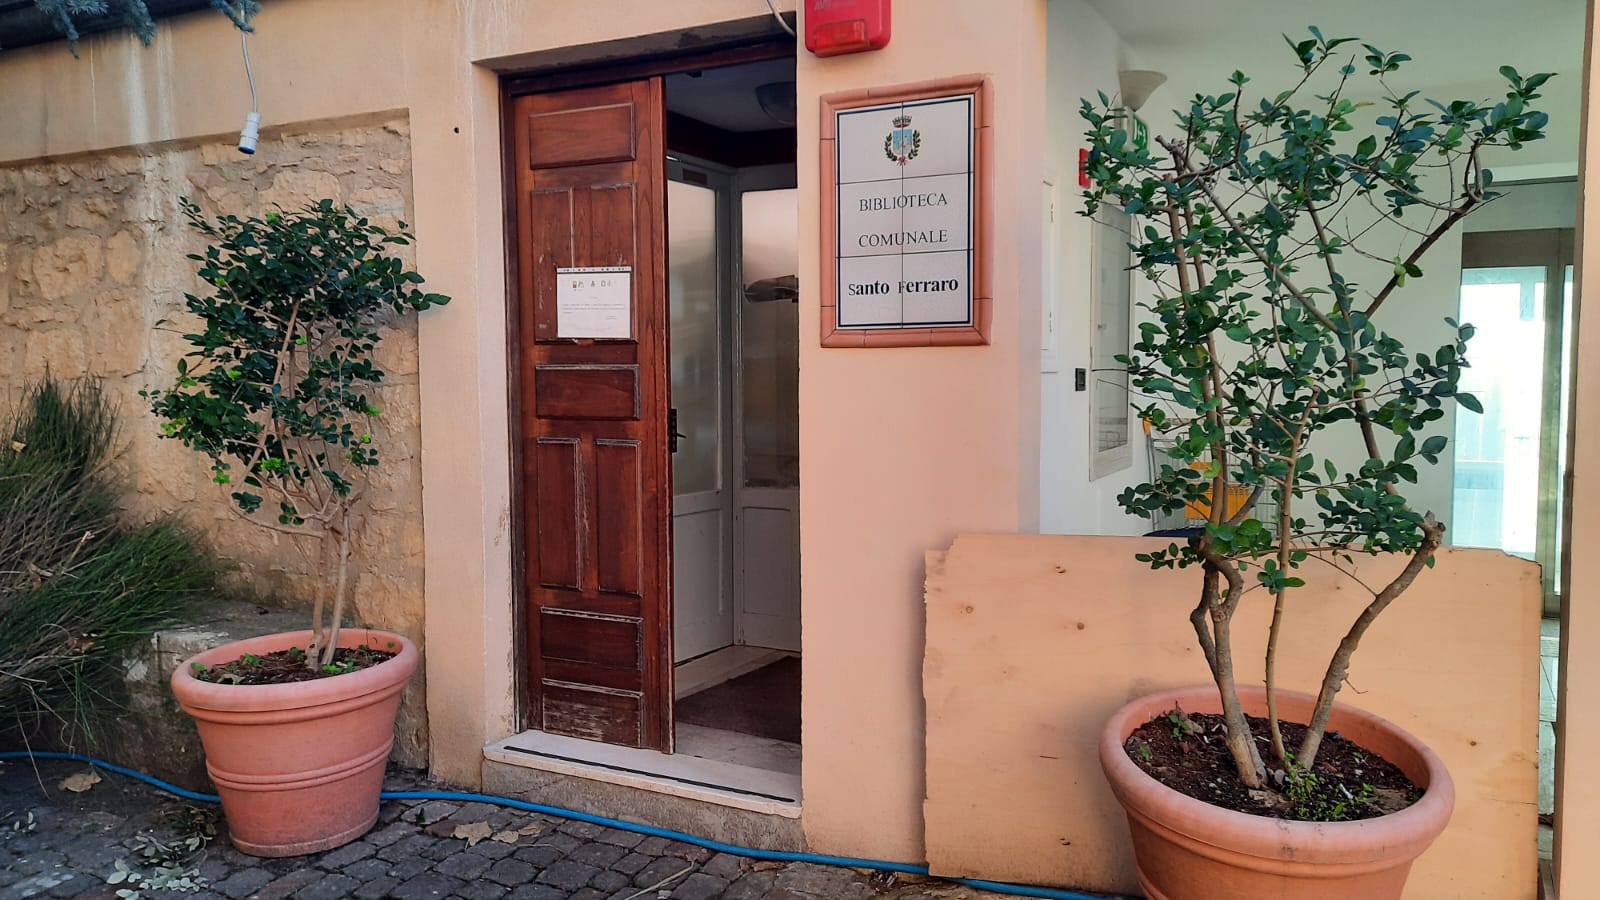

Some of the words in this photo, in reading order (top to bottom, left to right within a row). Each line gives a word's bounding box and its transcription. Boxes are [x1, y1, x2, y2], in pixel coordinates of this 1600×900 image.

[859, 193, 948, 212] BIBLIOTECA
[858, 230, 948, 248] COMUNALE
[848, 280, 890, 296] Santo
[898, 278, 959, 294] Ferraro
